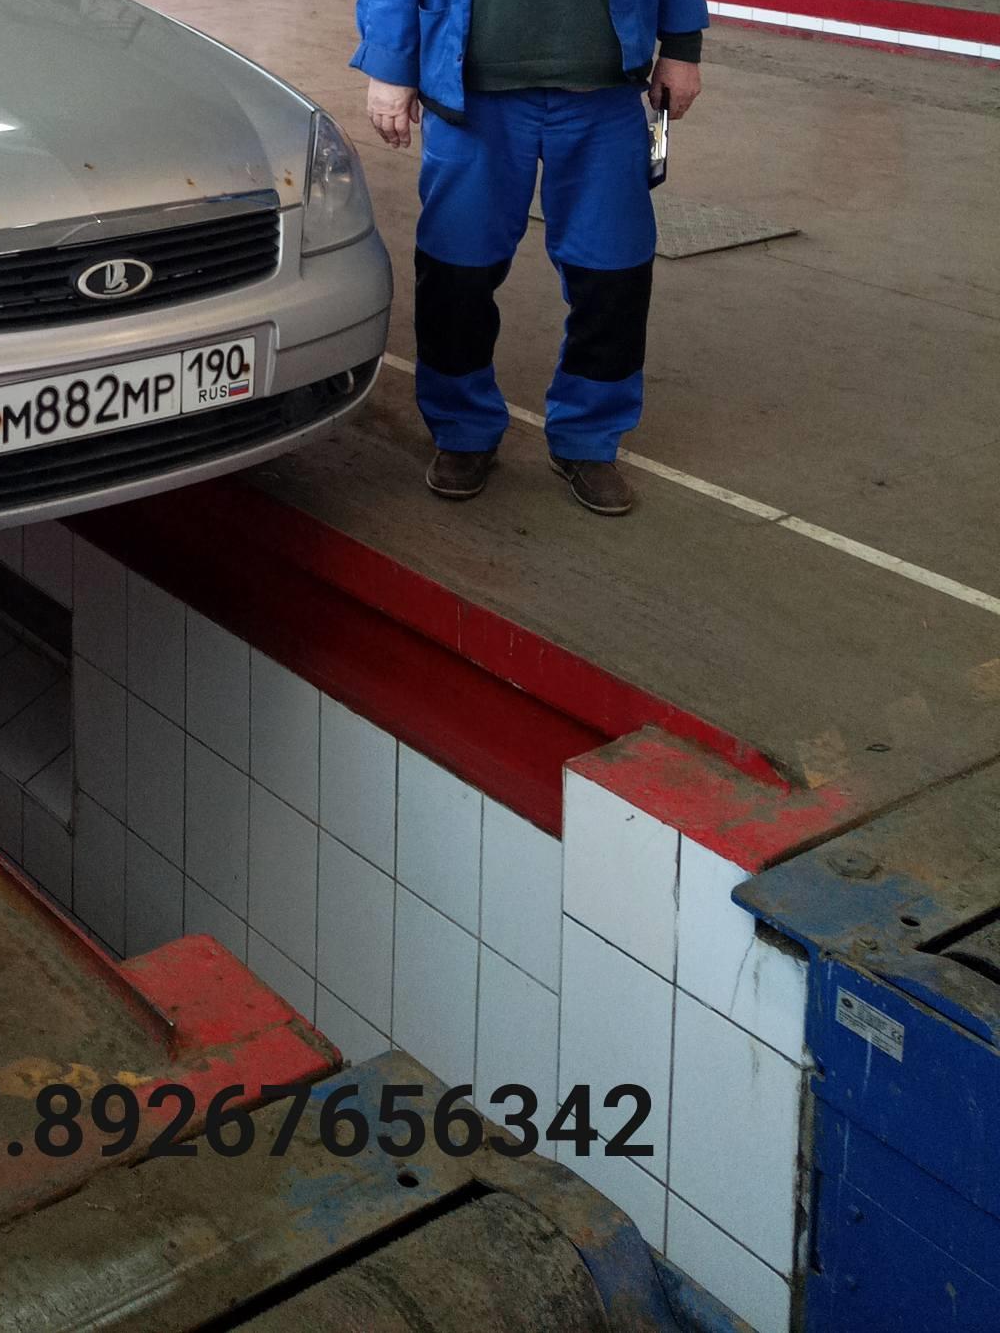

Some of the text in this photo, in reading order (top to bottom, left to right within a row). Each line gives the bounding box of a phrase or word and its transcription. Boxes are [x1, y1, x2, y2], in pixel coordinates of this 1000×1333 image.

[1, 344, 245, 444] М882МР 190
[198, 384, 227, 403] RUS
